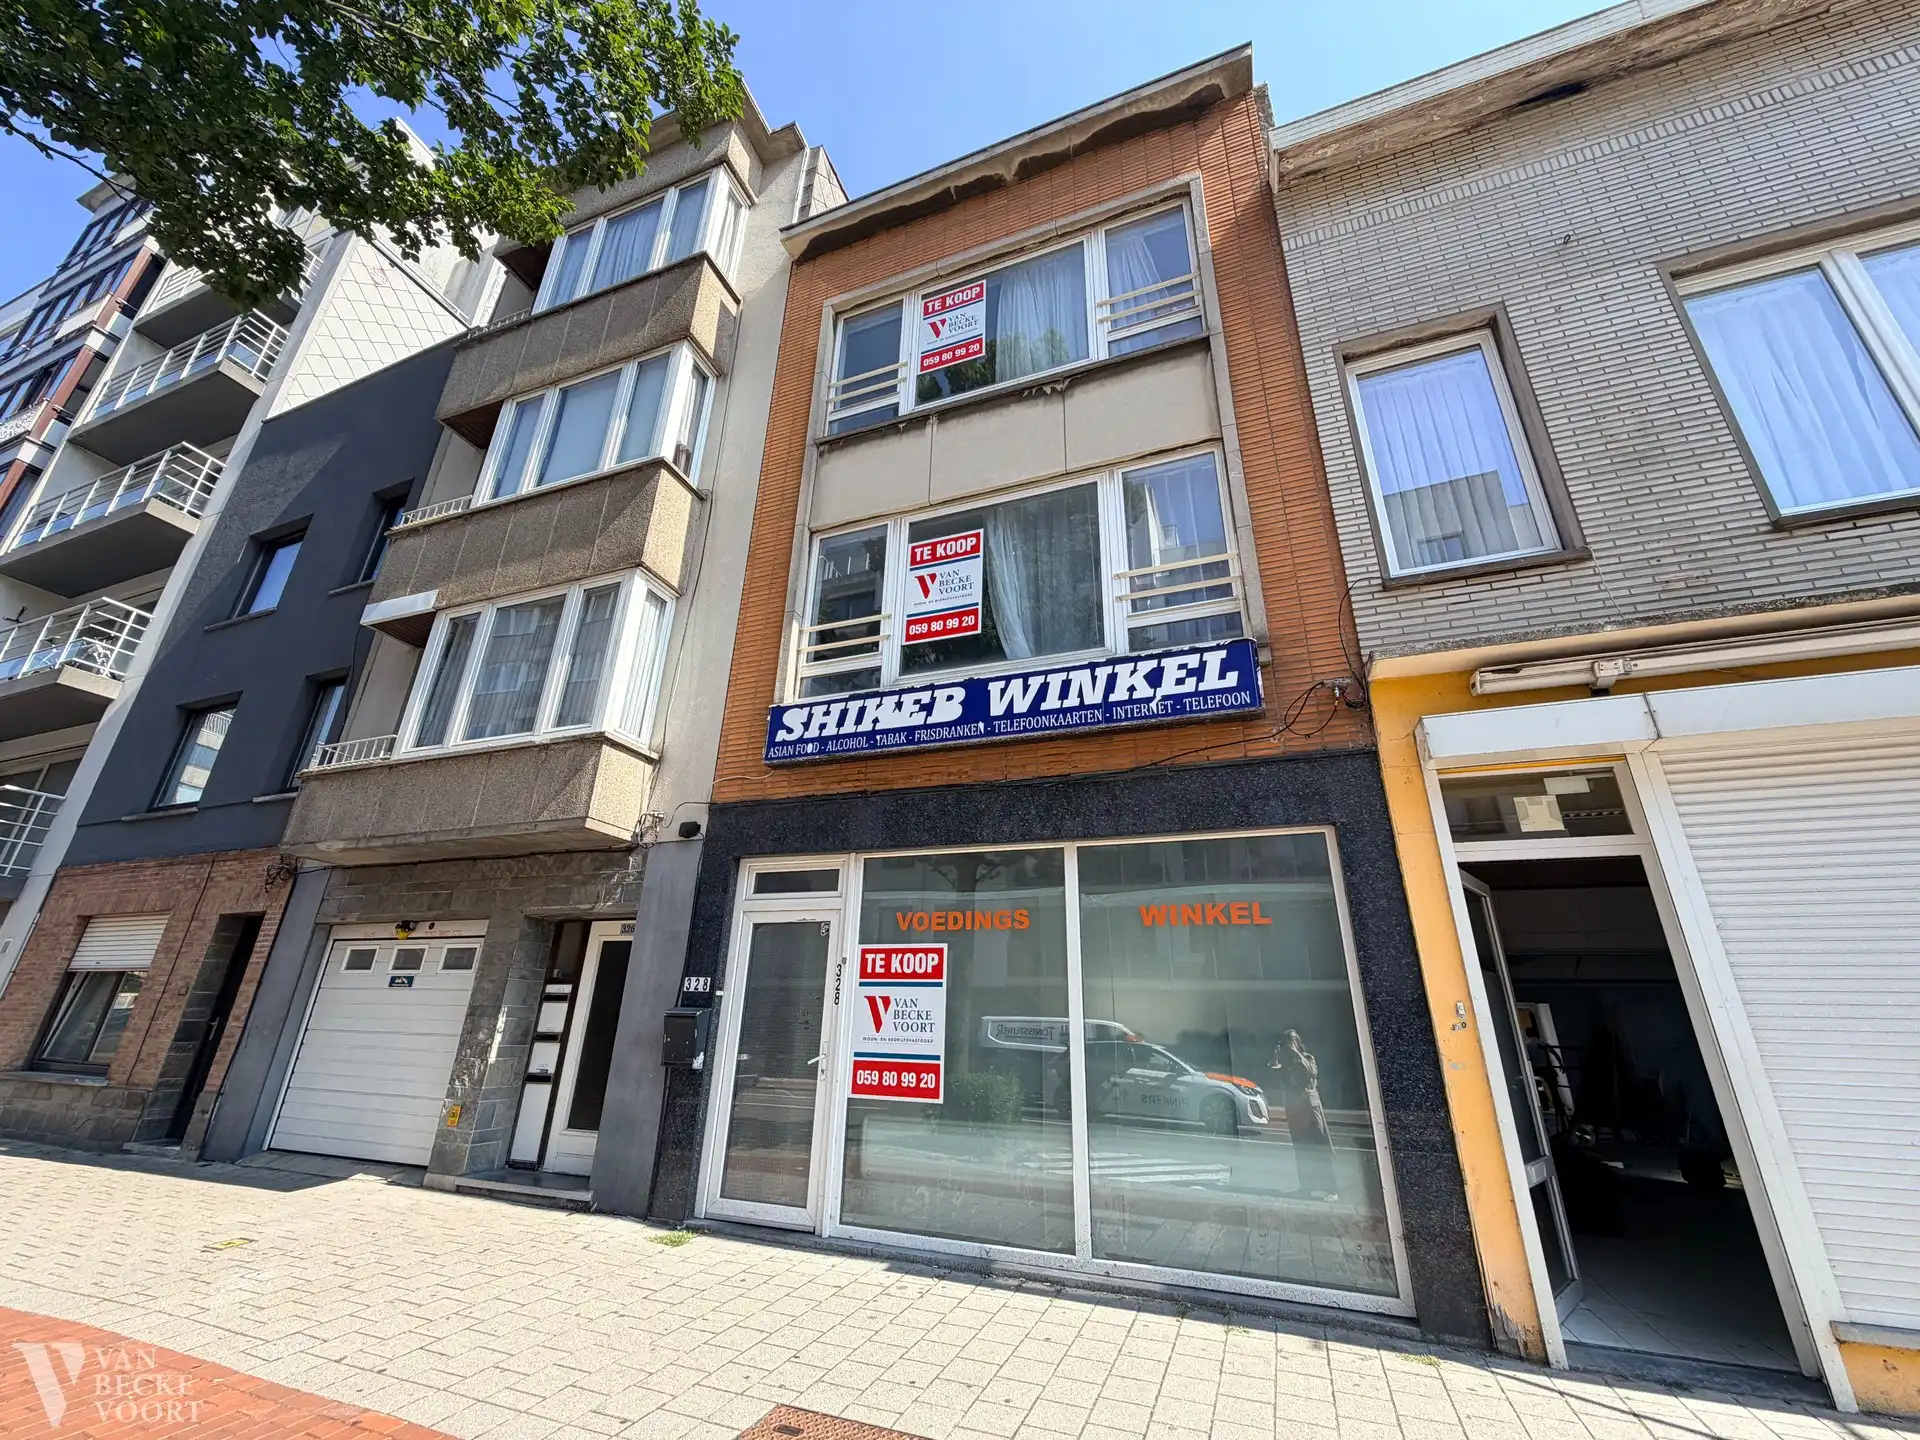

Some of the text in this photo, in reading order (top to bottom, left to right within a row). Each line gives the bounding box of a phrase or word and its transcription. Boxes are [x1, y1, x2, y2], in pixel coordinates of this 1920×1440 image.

[927, 286, 980, 313] TE KOOP
[948, 312, 967, 322] VAN
[923, 343, 980, 366] 059 80 99 20
[914, 537, 977, 562] TE KOOP
[939, 575, 972, 588] BECKE
[940, 569, 960, 579] VAN
[938, 582, 975, 595] VOORT
[909, 615, 975, 635] 059 80 99 20
[987, 649, 1239, 717] WINKEL
[768, 745, 794, 759] ASIAN
[795, 743, 820, 755] FOOD
[825, 737, 869, 752] ALCOHOL
[876, 732, 907, 746] TABAK
[914, 721, 985, 741] FRISDRANKEN
[993, 708, 1103, 733] TELEFOONKAARTEN
[1112, 699, 1174, 720] INTERNET
[1185, 690, 1251, 711] TELEFOON
[896, 902, 1273, 931] VOEDINGS WINKEL
[621, 924, 636, 934] 326
[865, 953, 939, 974] TE KOOP
[685, 978, 709, 991] 328
[834, 963, 843, 1006] 328
[894, 998, 918, 1009] VAN
[893, 1010, 932, 1021] BECKE
[893, 1022, 936, 1033] VOORT
[856, 1069, 936, 1089] 059 80 99 20
